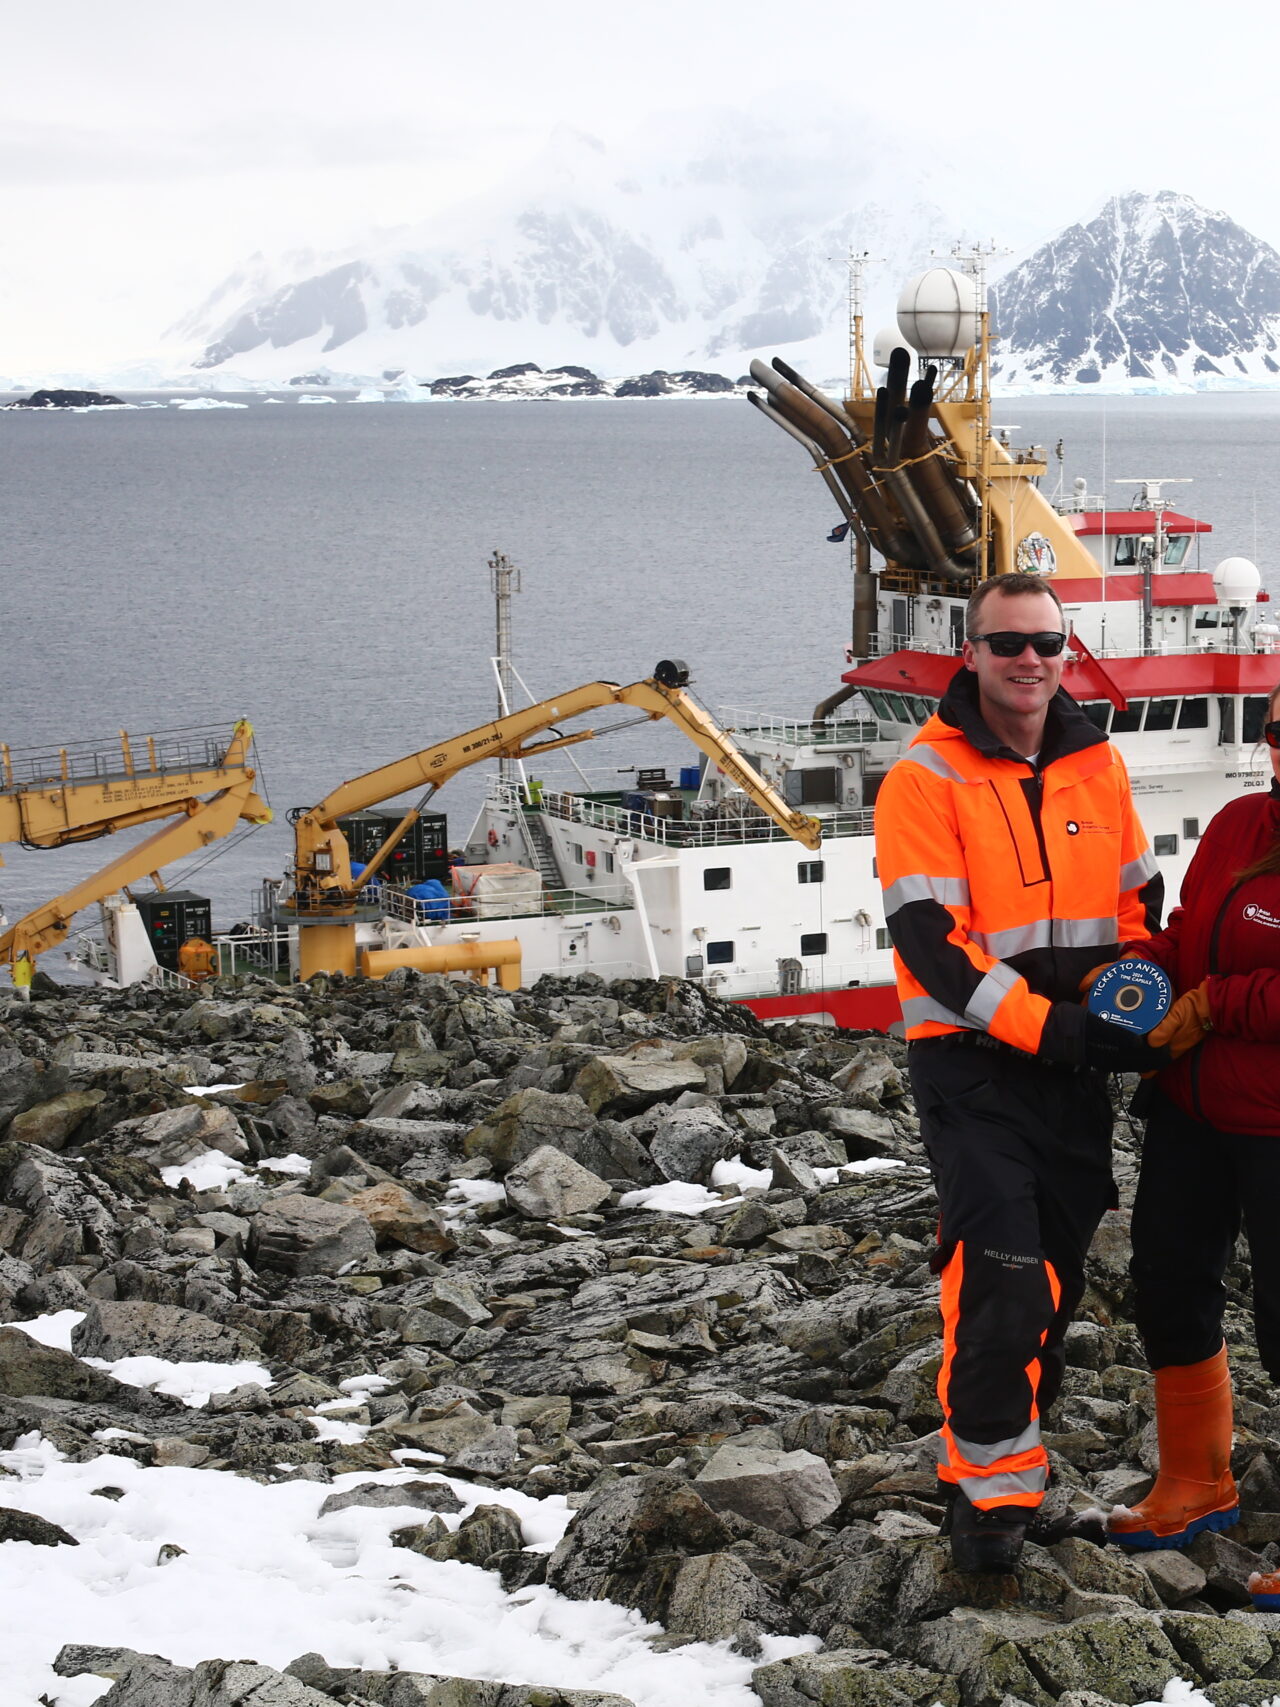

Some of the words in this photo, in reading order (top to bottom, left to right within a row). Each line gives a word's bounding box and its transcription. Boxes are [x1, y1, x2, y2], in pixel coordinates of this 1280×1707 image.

[1093, 967, 1118, 997] TICKET
[1119, 962, 1134, 971] TO
[1135, 962, 1168, 1011] ANTARCTICA
[1131, 977, 1152, 985] CAPSULE
[984, 1248, 1011, 1261] HELLY
[1011, 1255, 1039, 1264] HANSEN
